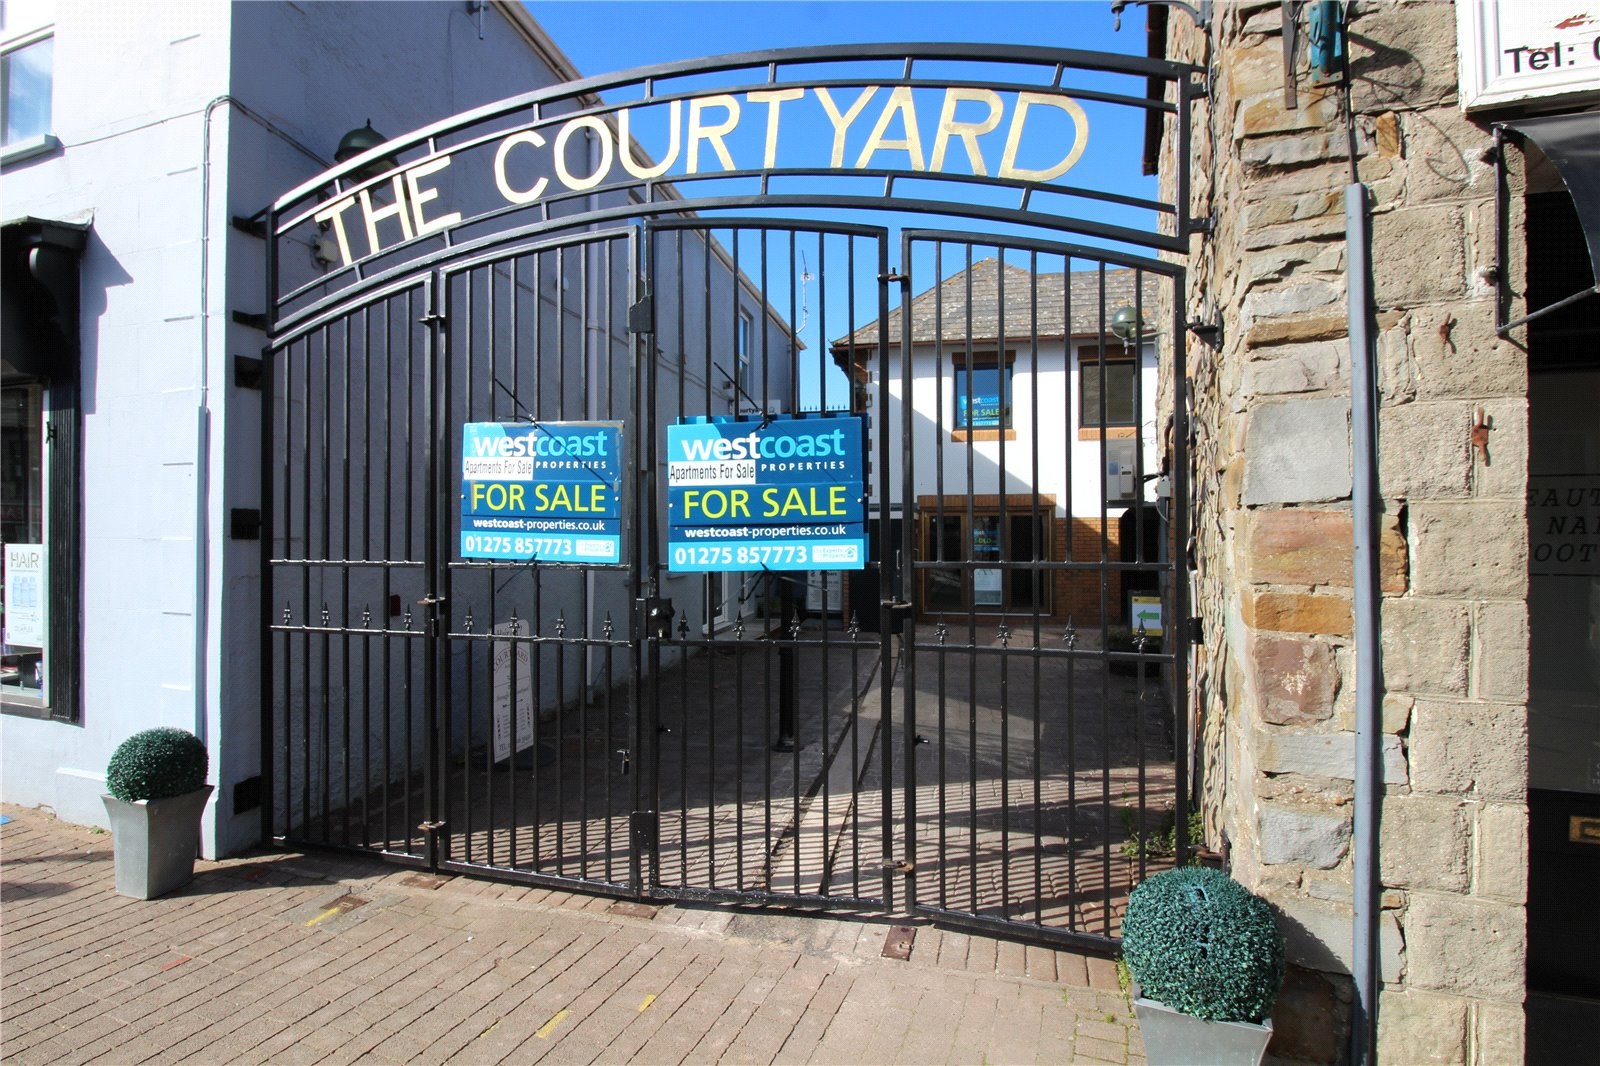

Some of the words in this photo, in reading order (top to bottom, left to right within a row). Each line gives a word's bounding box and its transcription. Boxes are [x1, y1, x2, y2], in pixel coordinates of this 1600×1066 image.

[1504, 41, 1575, 73] Tel:
[314, 155, 462, 267] THE
[493, 86, 1089, 204] COURTYARD
[473, 431, 608, 457] westcoast
[681, 428, 846, 461] westcoast
[465, 460, 501, 475] Apartments
[504, 460, 515, 474] For
[517, 460, 532, 474] Sale
[535, 461, 607, 469] PROPERTIES
[670, 465, 717, 483] Apartments
[719, 464, 734, 479] For
[736, 463, 755, 479] Sale
[761, 461, 846, 472] PROPERTIES
[473, 484, 525, 511] FOR
[535, 484, 606, 512] SALE
[684, 489, 751, 519] FOR
[762, 486, 847, 517] SALE
[1527, 487, 1600, 507] EAUT
[473, 519, 605, 531] westcoast-properties.co.uk
[685, 524, 847, 538] westcoast-properties.co.uk
[465, 536, 512, 553] 01275
[514, 537, 572, 555] 857773
[675, 547, 733, 565] 01275
[737, 545, 808, 564] 857773
[1533, 543, 1598, 562] OOT
[10, 552, 39, 569] HAIR
